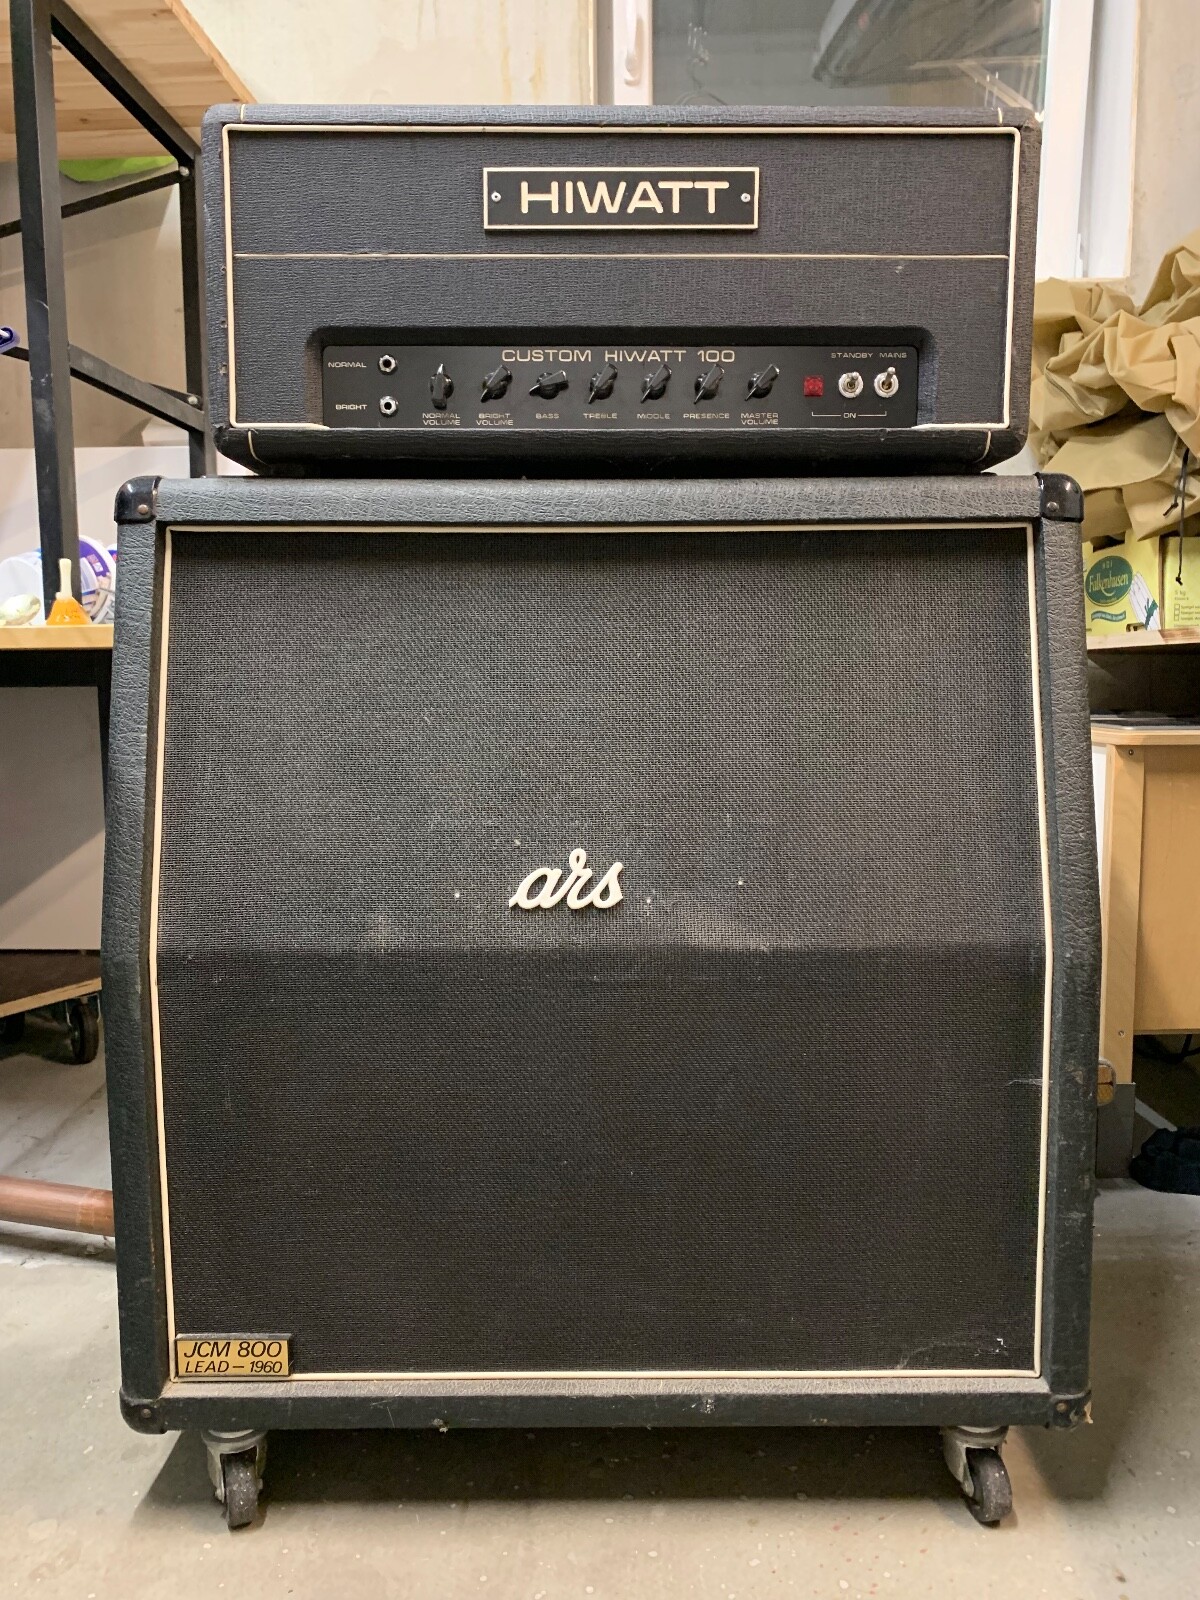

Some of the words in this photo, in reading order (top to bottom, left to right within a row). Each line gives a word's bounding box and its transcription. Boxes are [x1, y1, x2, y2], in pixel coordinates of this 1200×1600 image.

[520, 180, 730, 214] HIWATT
[501, 349, 592, 362] CUSTOM
[604, 349, 687, 362] HIWATT
[697, 349, 736, 362] 100
[335, 403, 368, 411] BRIGHT
[535, 412, 560, 420] BASS
[583, 412, 618, 420] TREBLE
[682, 412, 730, 420] PRESENCE
[740, 418, 779, 426] VOLUME
[508, 847, 624, 910] ars
[183, 1341, 231, 1358] JCM
[237, 1341, 283, 1358] 800
[185, 1360, 230, 1373] LEAD
[249, 1360, 283, 1374] 1960
